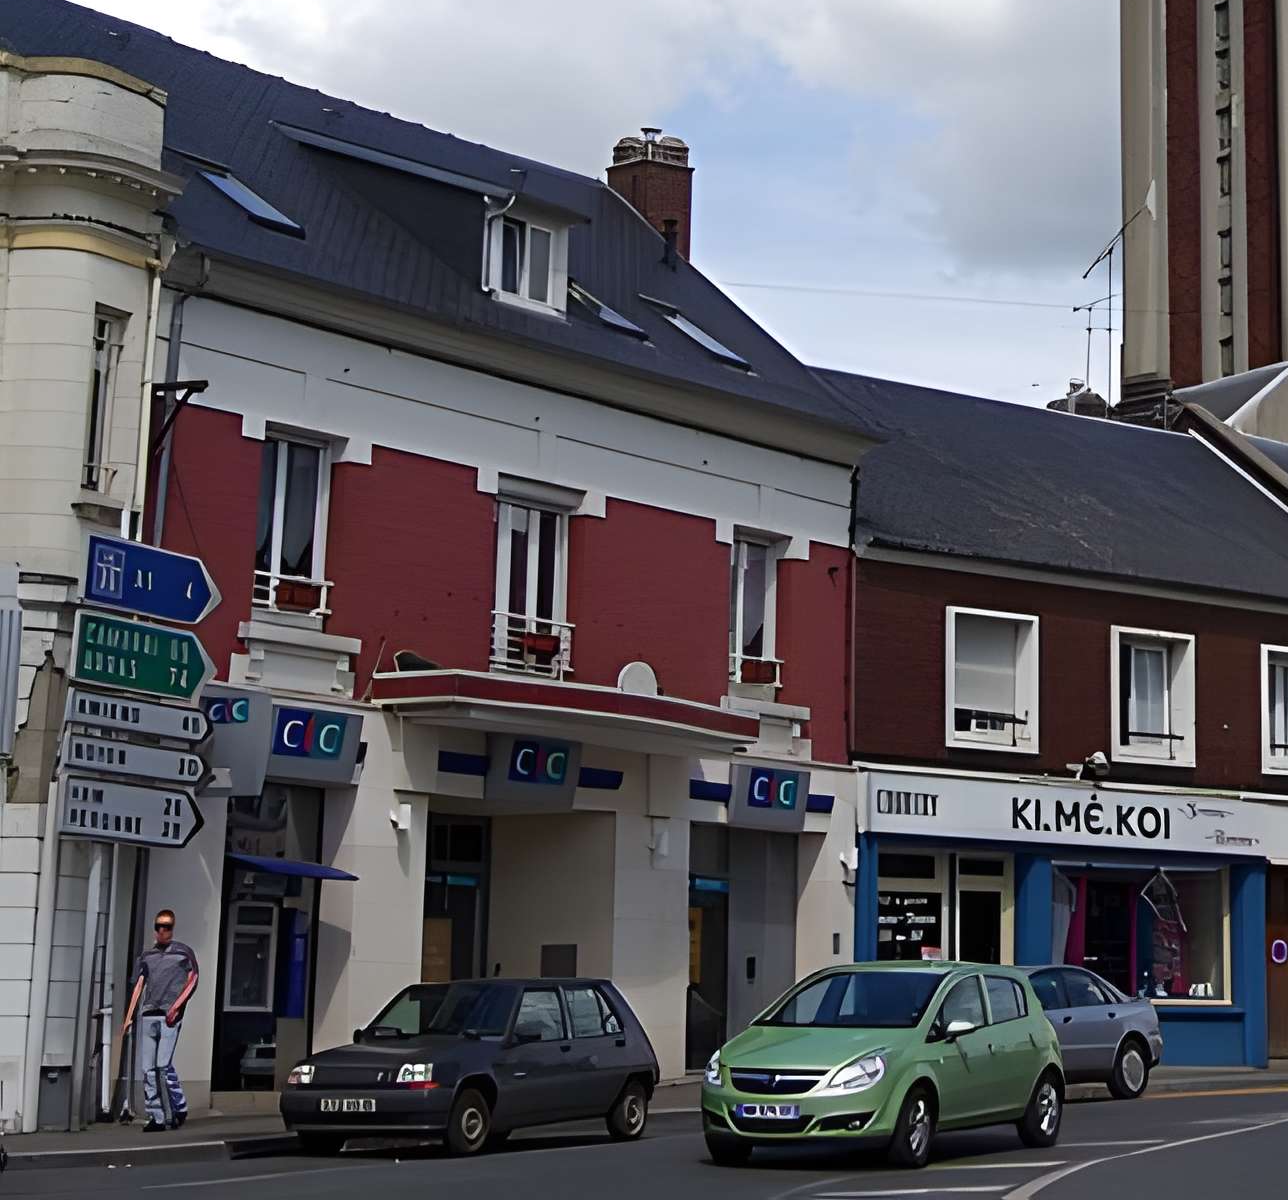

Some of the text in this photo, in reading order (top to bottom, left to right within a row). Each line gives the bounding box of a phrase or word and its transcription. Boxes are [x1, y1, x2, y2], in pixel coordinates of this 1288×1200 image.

[208, 700, 248, 721] CIC
[283, 714, 341, 753] CIC
[516, 748, 566, 780] CIC
[753, 776, 795, 805] CIC
